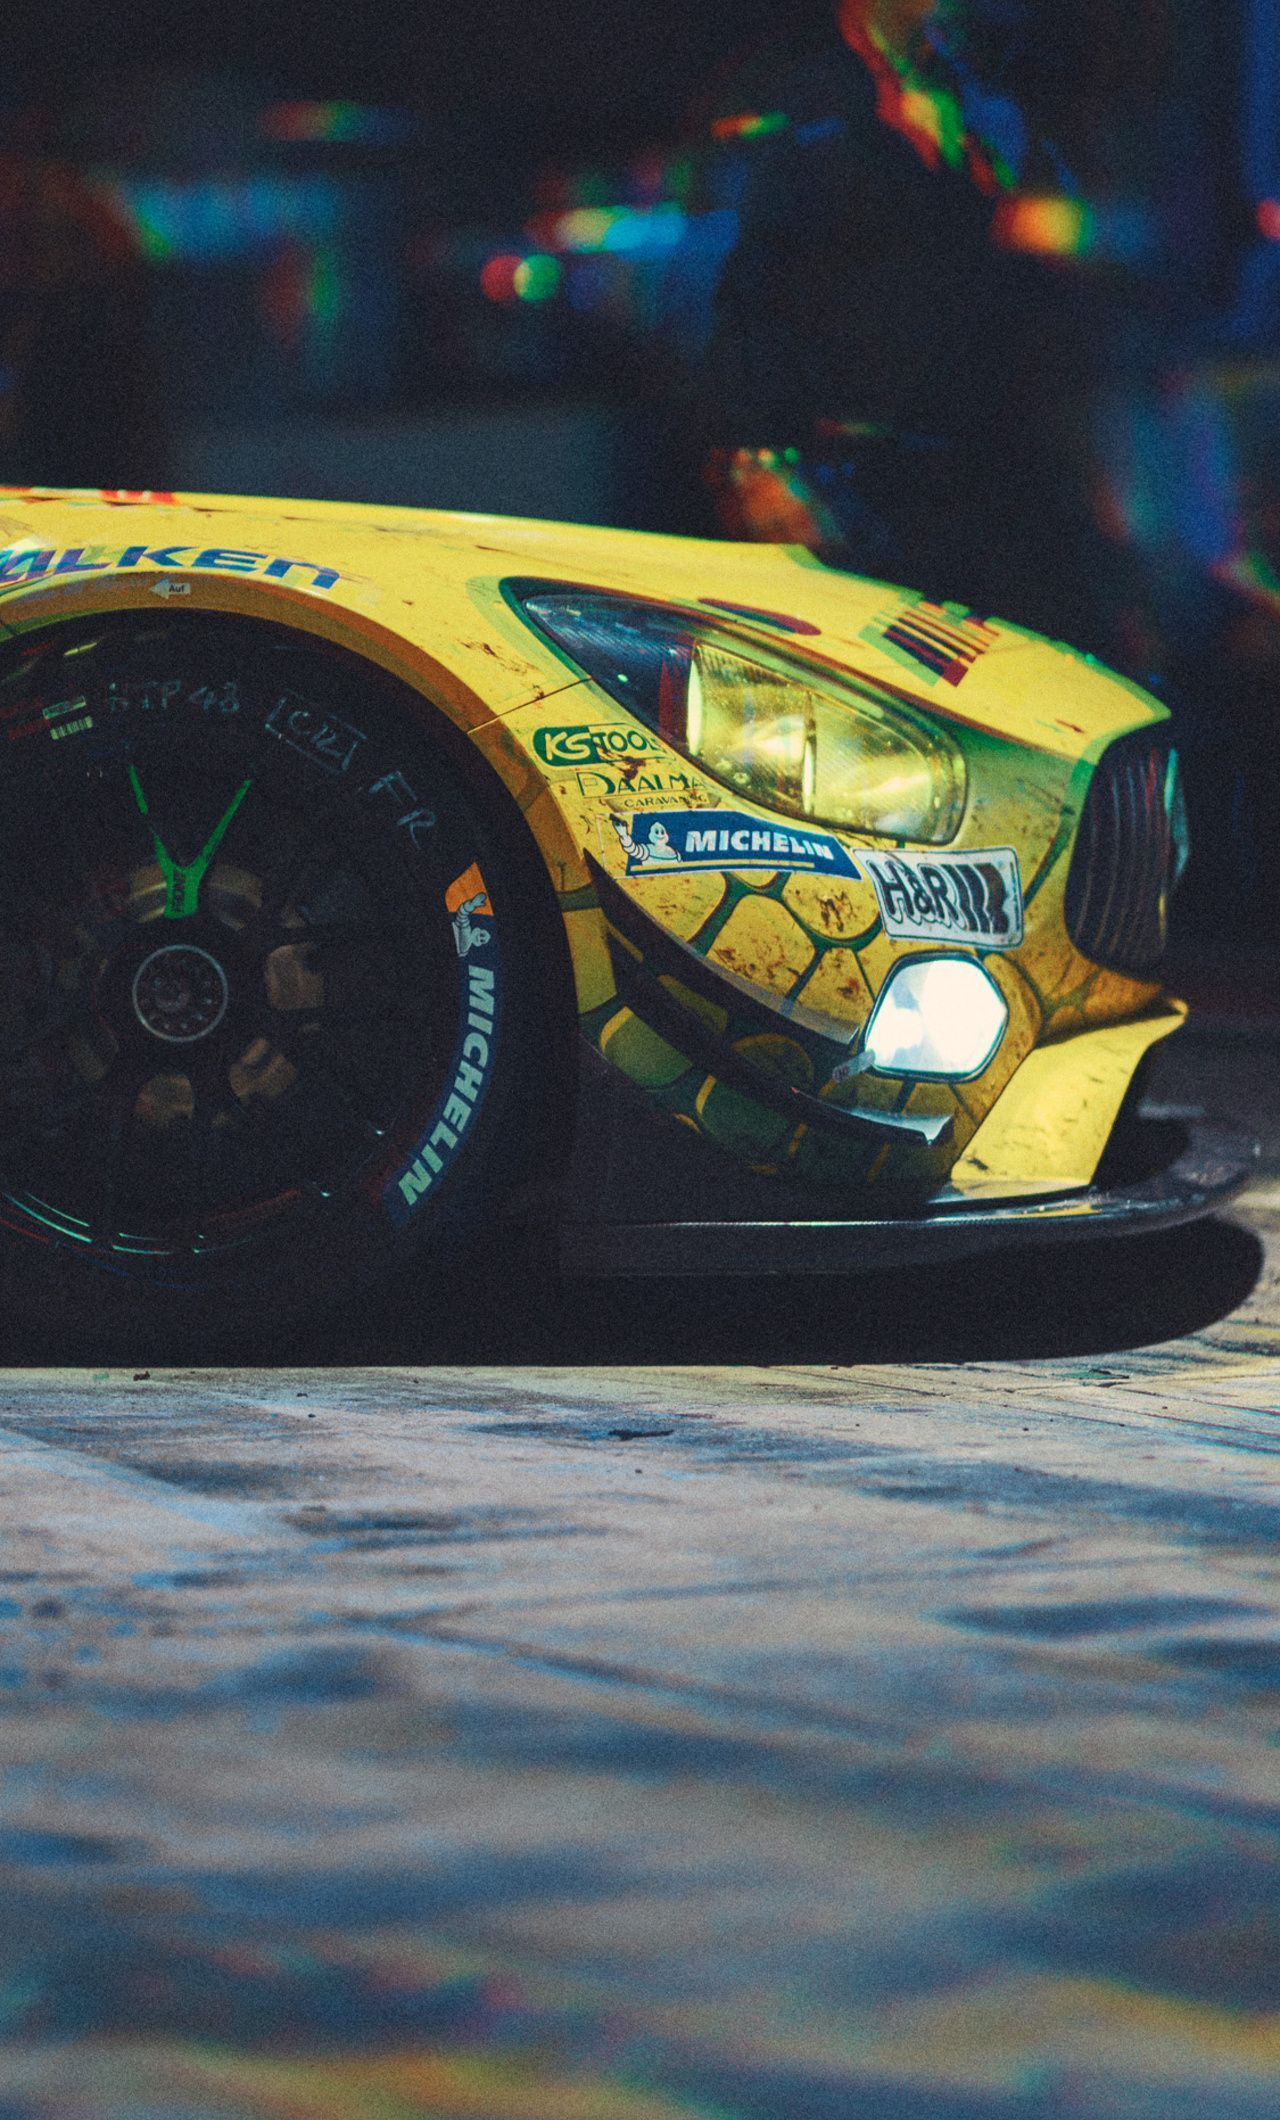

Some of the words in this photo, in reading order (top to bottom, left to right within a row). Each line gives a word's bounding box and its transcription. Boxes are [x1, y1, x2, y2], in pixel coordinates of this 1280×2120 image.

[168, 583, 186, 593] Auf
[684, 830, 834, 861] MICHELIN
[398, 965, 496, 1206] MICHELIN
